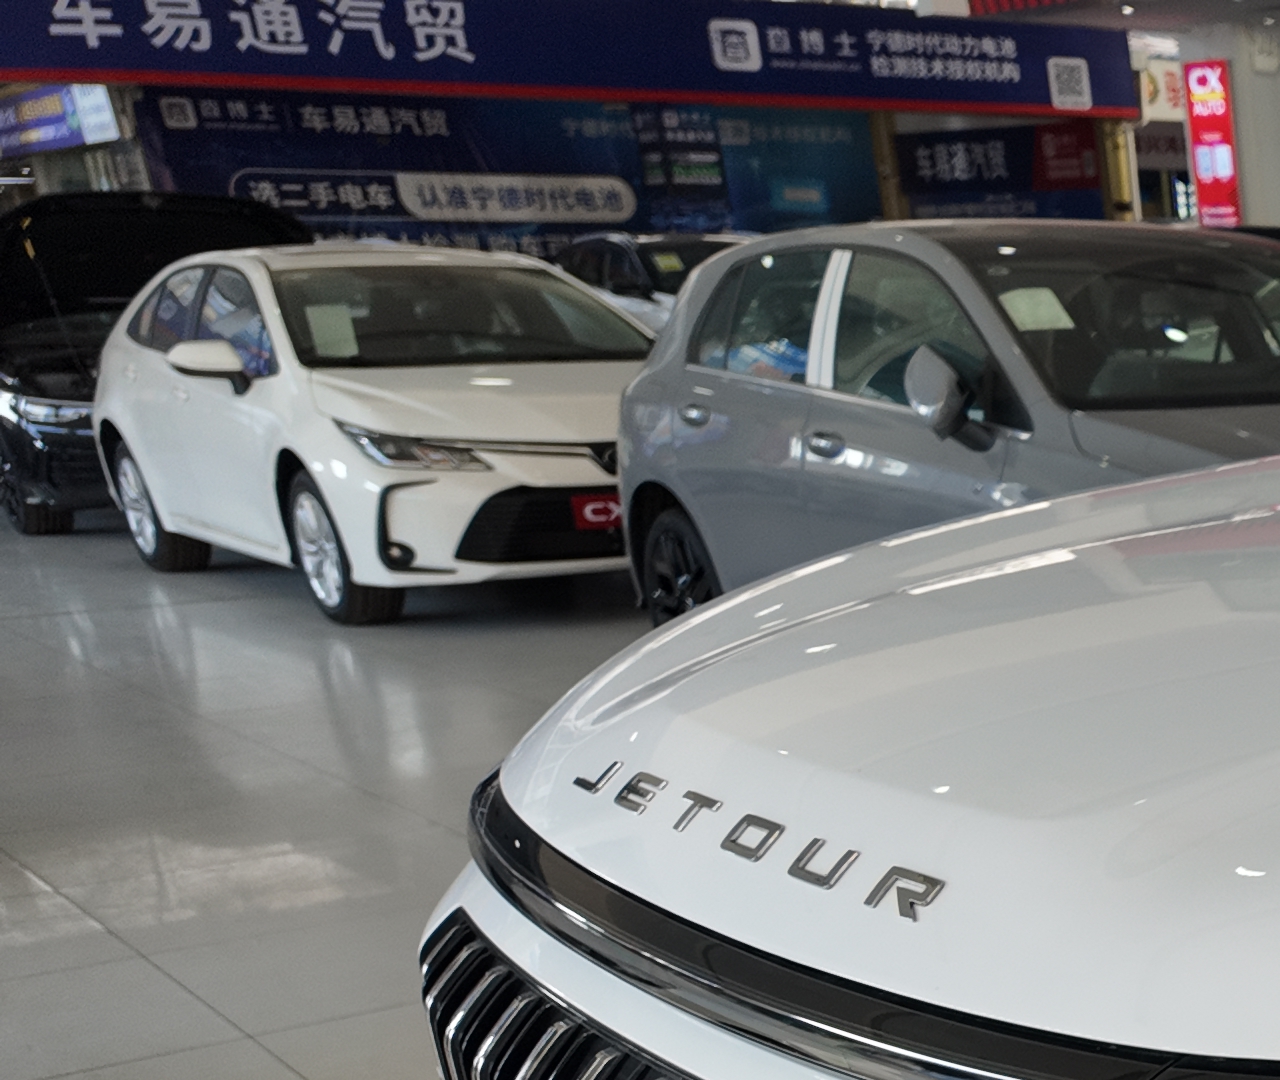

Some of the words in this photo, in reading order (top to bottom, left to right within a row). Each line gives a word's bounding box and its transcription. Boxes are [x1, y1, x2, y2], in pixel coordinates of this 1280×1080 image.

[48, 0, 475, 63] 车易通汽贸
[1187, 66, 1225, 95] CX
[300, 103, 450, 138] 车易通汽贸
[573, 760, 947, 922] JETOUR
